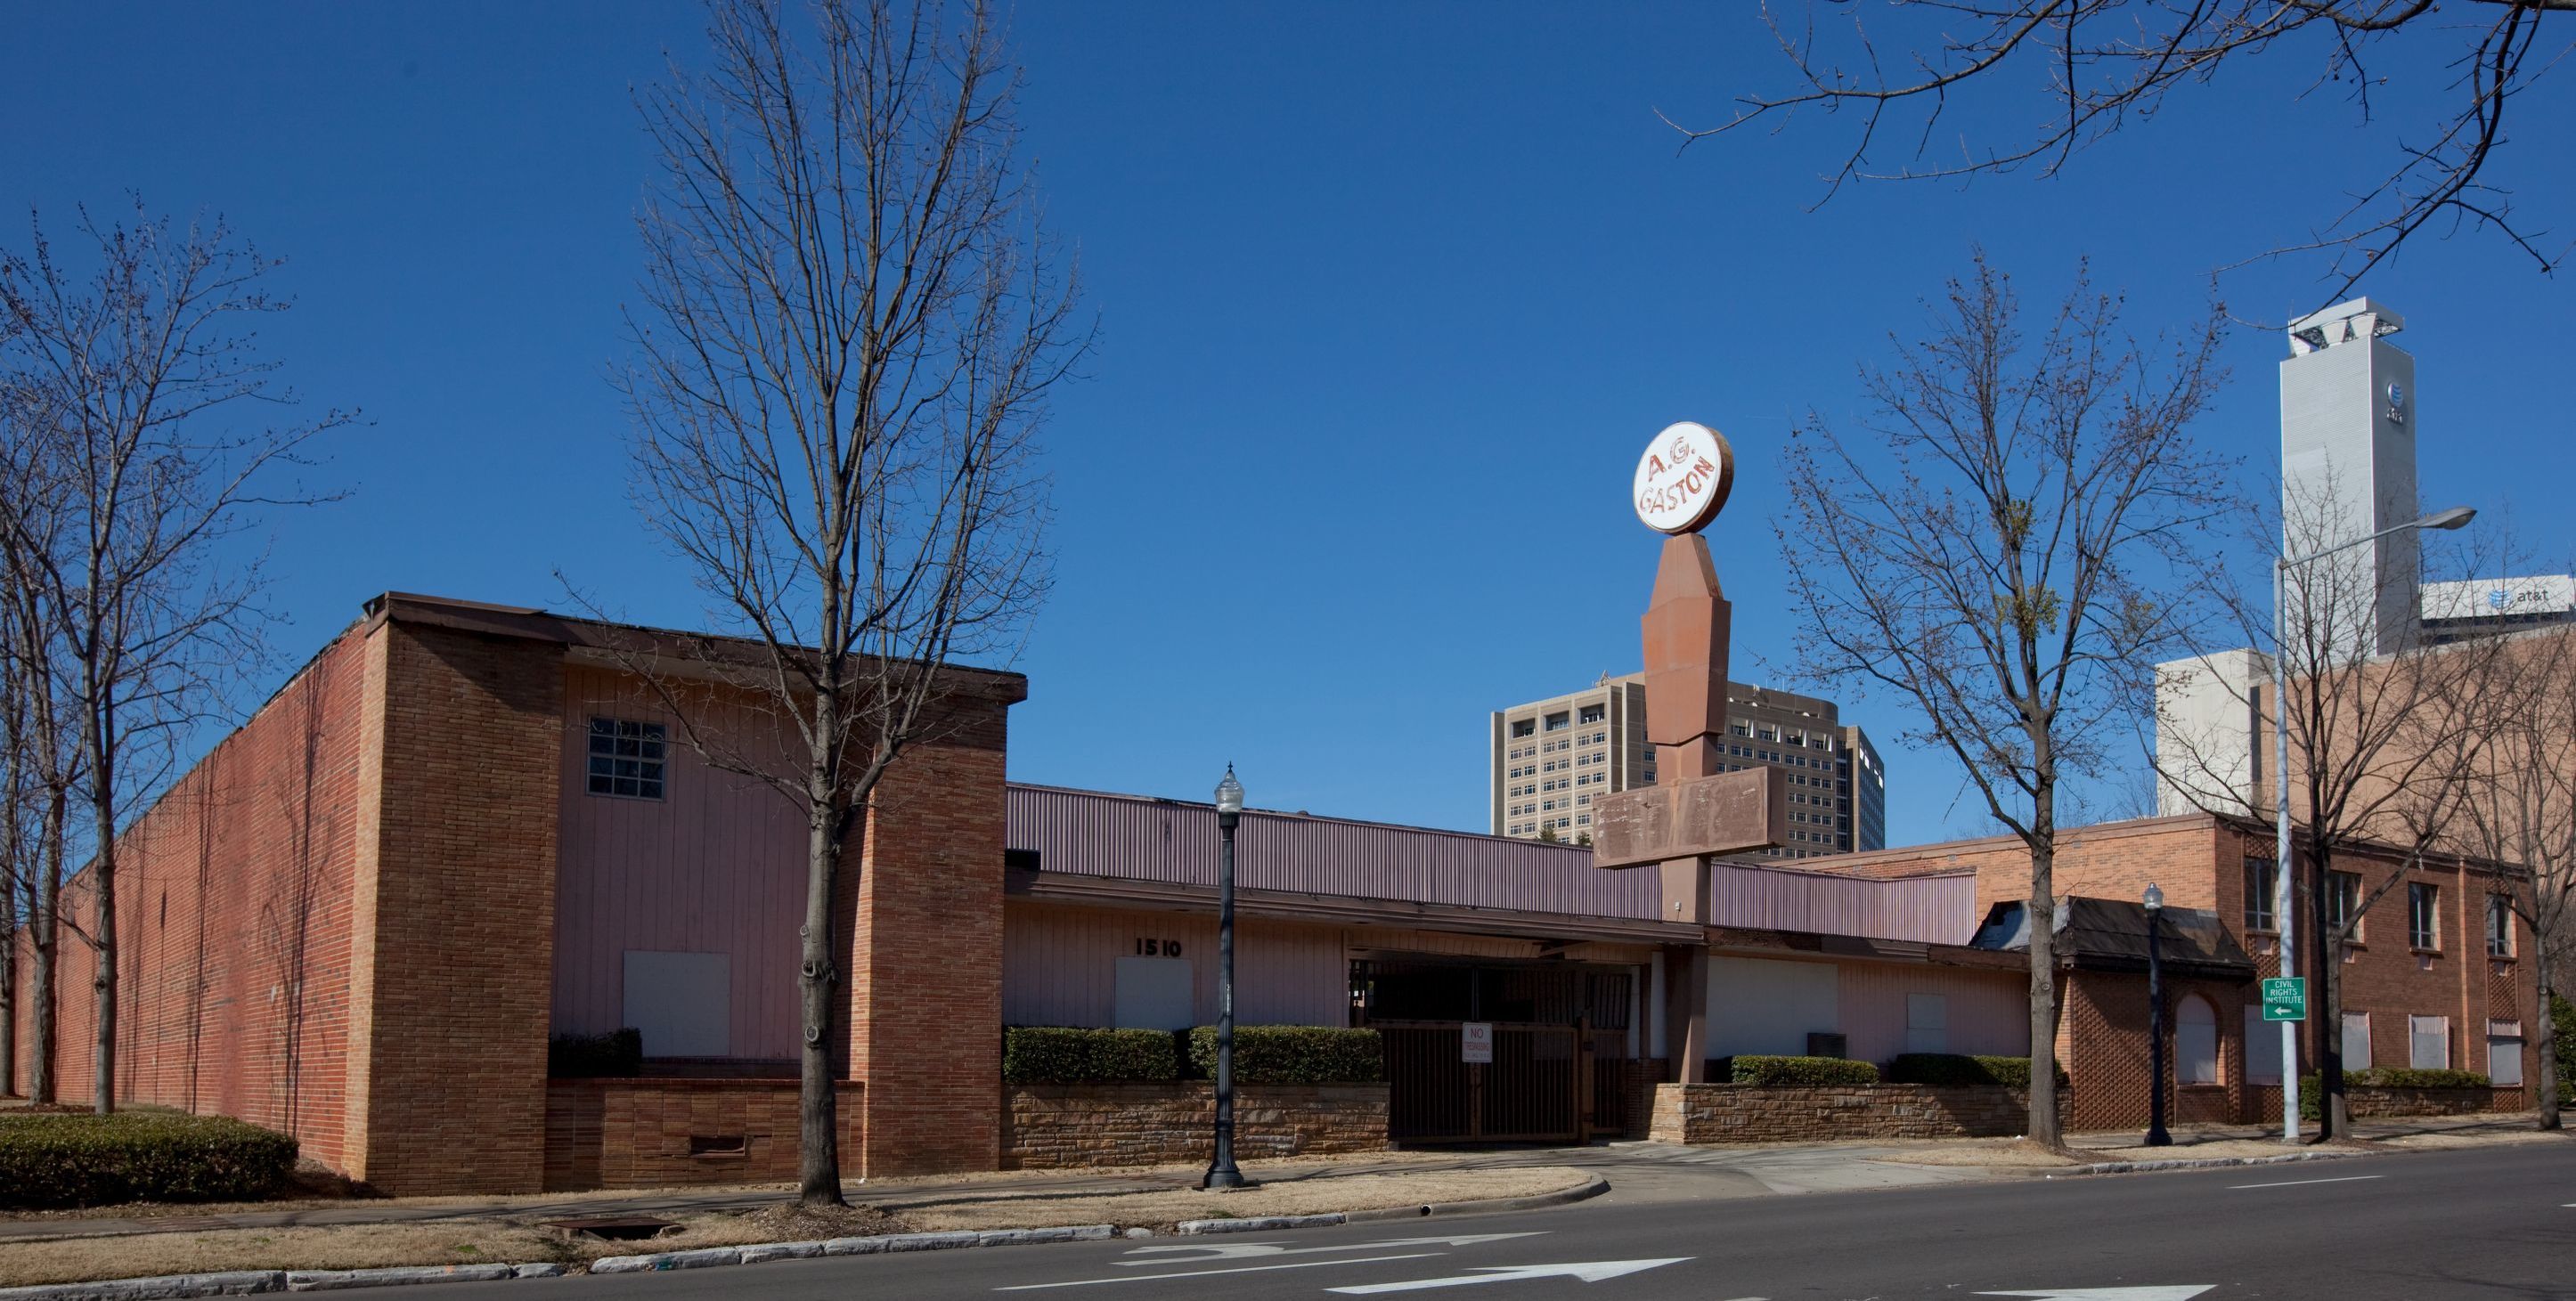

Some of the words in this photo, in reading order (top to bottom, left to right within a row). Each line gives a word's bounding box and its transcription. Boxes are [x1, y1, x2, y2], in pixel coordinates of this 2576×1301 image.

[1648, 436, 1696, 482] A.G.
[1640, 456, 1716, 514] GASTON
[2517, 590, 2549, 602] at&t
[1137, 938, 1182, 957] 1510
[2275, 980, 2295, 988] CIVIL
[2270, 988, 2298, 996] RIGHTS
[2265, 996, 2303, 1004] INSTITUTE
[1470, 1028, 1484, 1038] NO
